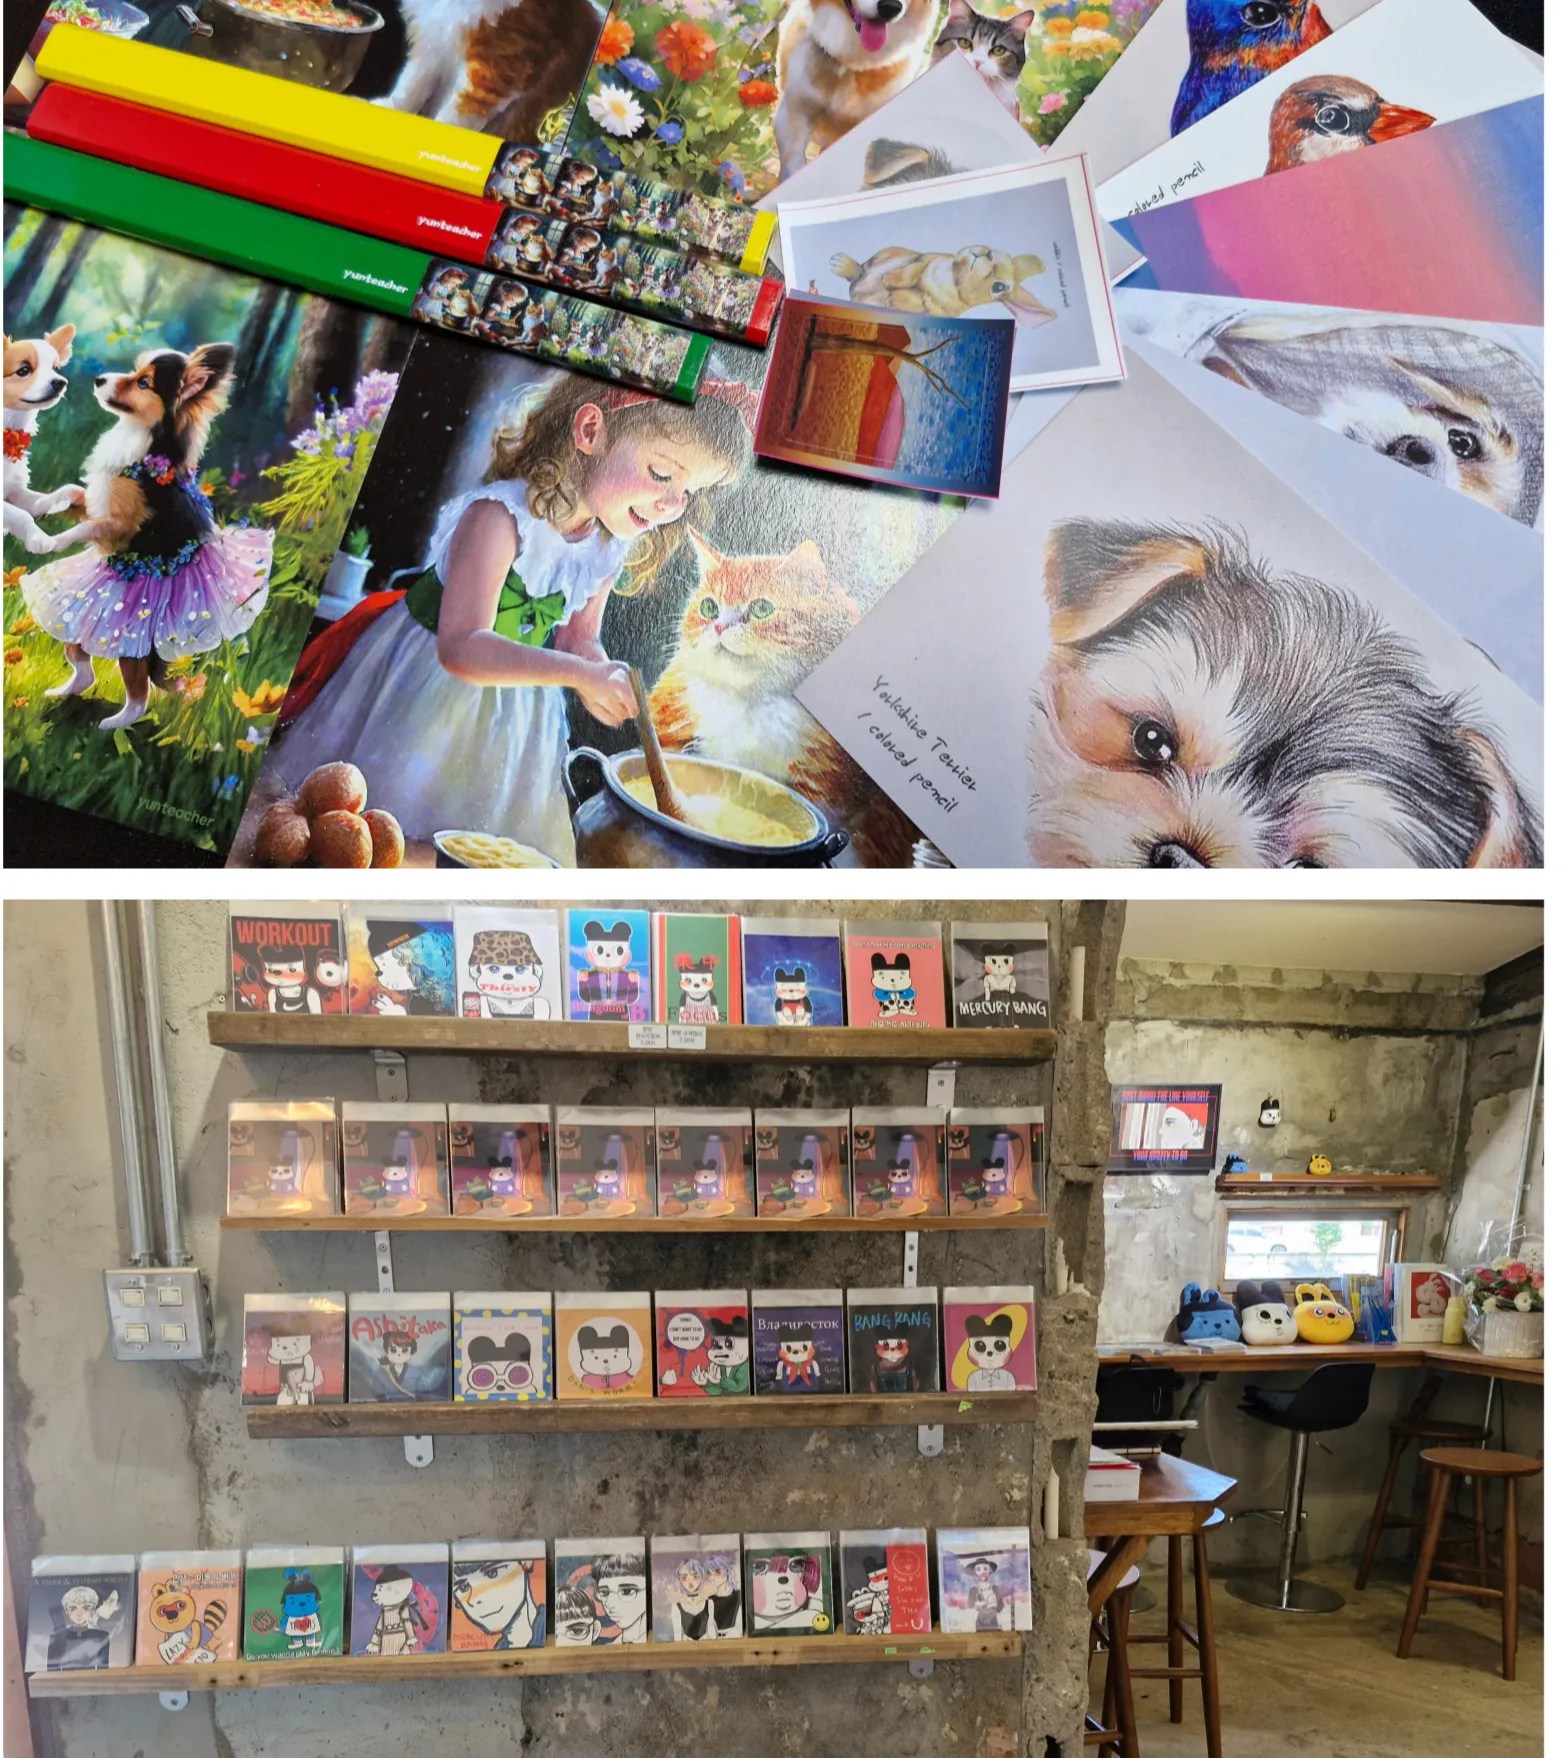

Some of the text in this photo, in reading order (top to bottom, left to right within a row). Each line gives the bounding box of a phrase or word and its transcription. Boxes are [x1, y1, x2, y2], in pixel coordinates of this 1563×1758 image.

[418, 150, 482, 173] yunteacher
[1170, 160, 1205, 196] pencil
[416, 216, 483, 240] yunteacher
[343, 269, 409, 294] yunteacher
[872, 674, 977, 792] Yorkshire Terrier
[869, 726, 918, 768] colored
[909, 772, 960, 814] pencil
[137, 797, 215, 827] yunteacher
[236, 919, 332, 947] WORKOUT
[958, 1001, 1047, 1018] MERCURY BANG
[352, 1314, 447, 1343] Ashitaka
[854, 1311, 932, 1332] BANG BANG
[247, 1652, 256, 1661] Do
[257, 1652, 270, 1662] you
